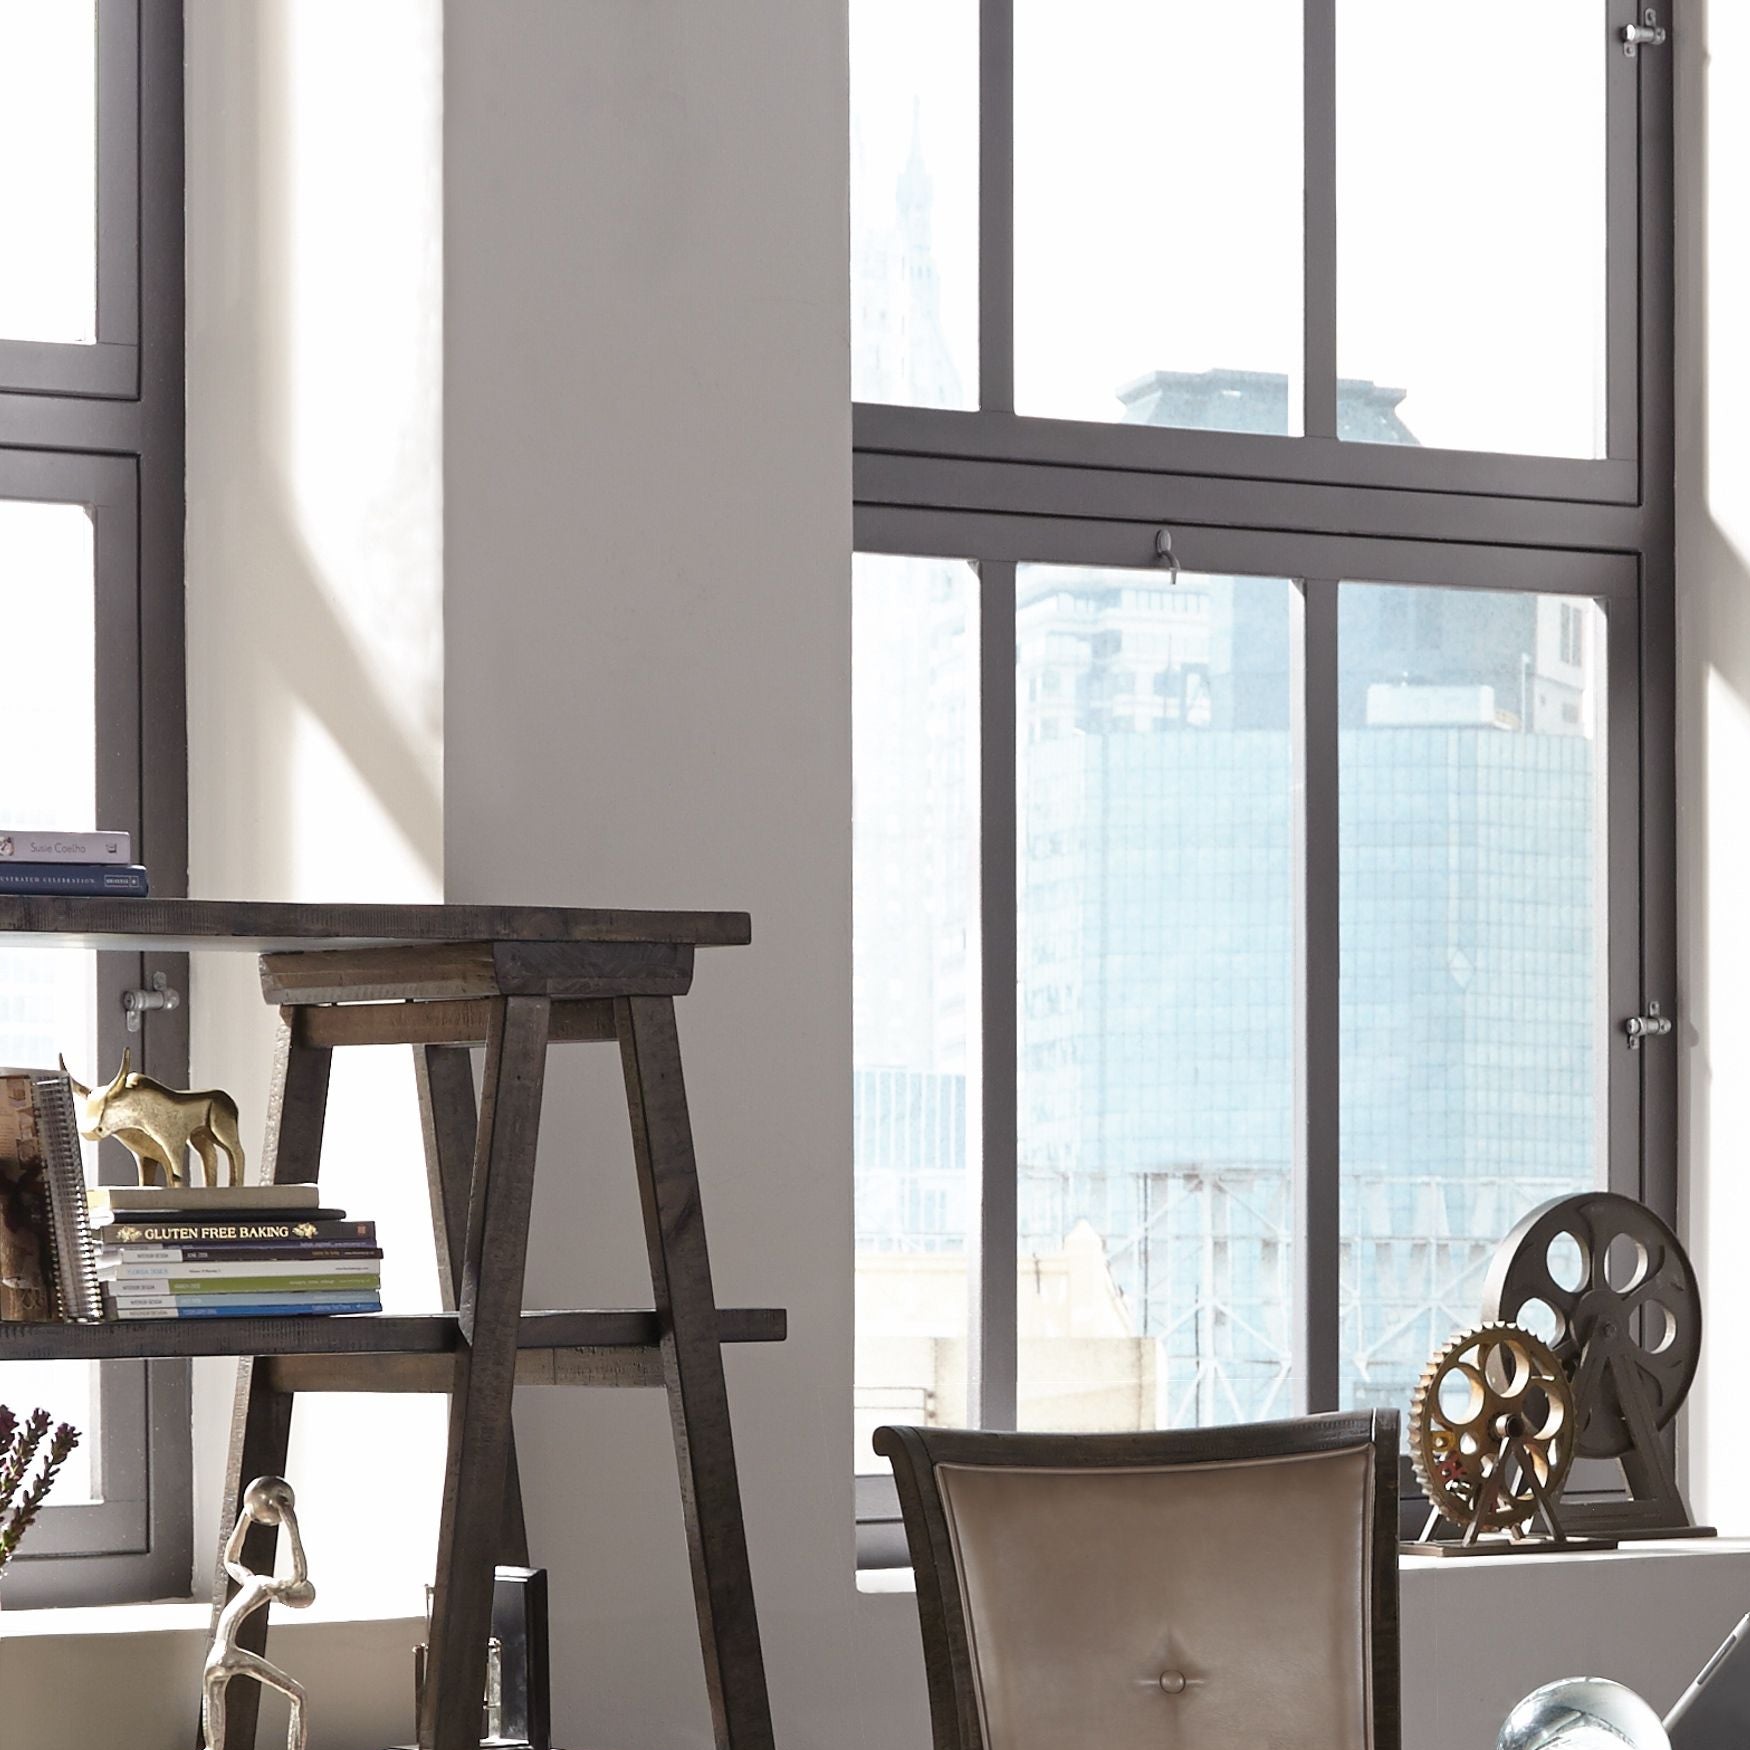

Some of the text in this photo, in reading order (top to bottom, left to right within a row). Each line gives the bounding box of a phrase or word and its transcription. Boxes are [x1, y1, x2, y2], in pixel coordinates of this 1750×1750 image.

[54, 842, 86, 853] Coelho
[144, 1226, 289, 1240] GLUTEN FREE BAKING
